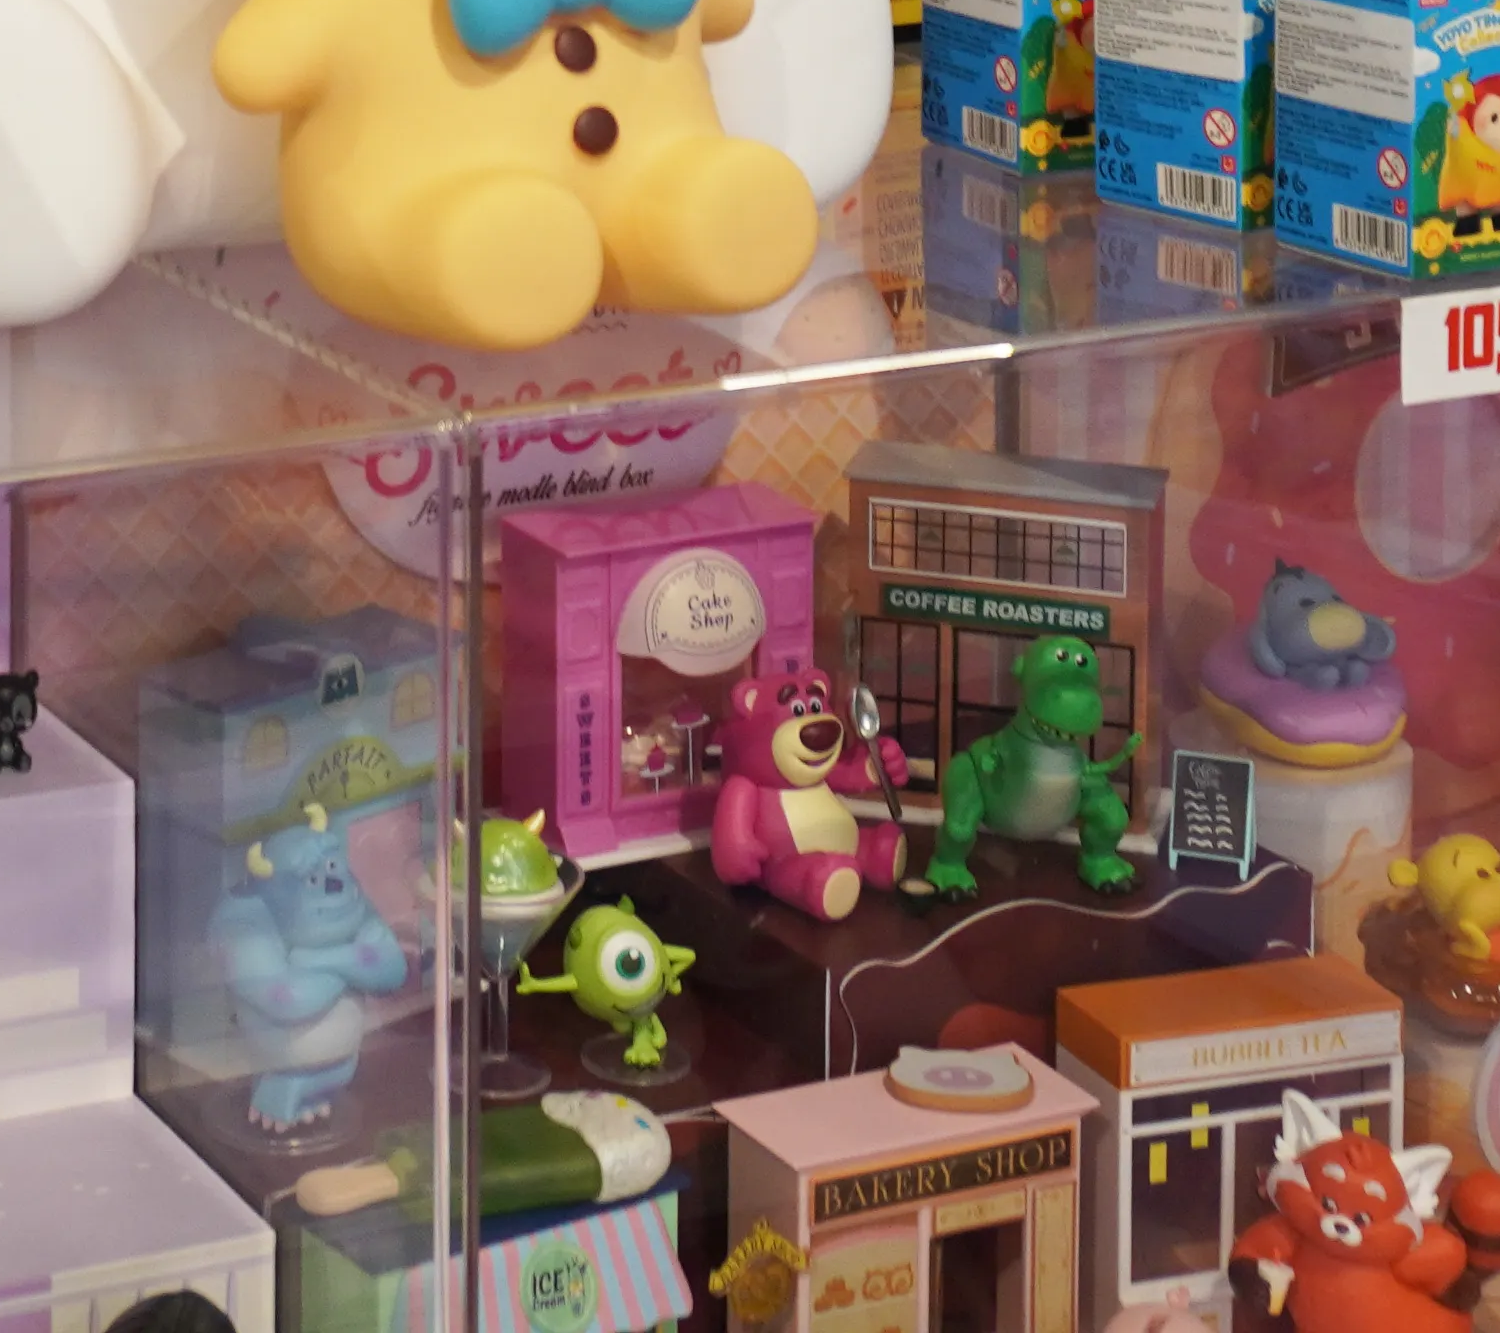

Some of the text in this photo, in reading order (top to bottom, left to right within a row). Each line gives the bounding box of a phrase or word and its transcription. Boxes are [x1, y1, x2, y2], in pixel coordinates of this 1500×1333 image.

[497, 473, 558, 507] modle
[562, 464, 613, 499] blind
[619, 462, 655, 491] box
[688, 590, 732, 613] Cake
[690, 608, 734, 631] Shop
[889, 589, 1105, 631] COFFEE ROASTERS
[307, 741, 387, 795] PARFAIT
[1191, 1028, 1349, 1069] BUBBLE TEA
[821, 1136, 1068, 1218] BAKERY SHOP
[532, 1269, 564, 1297] ICE
